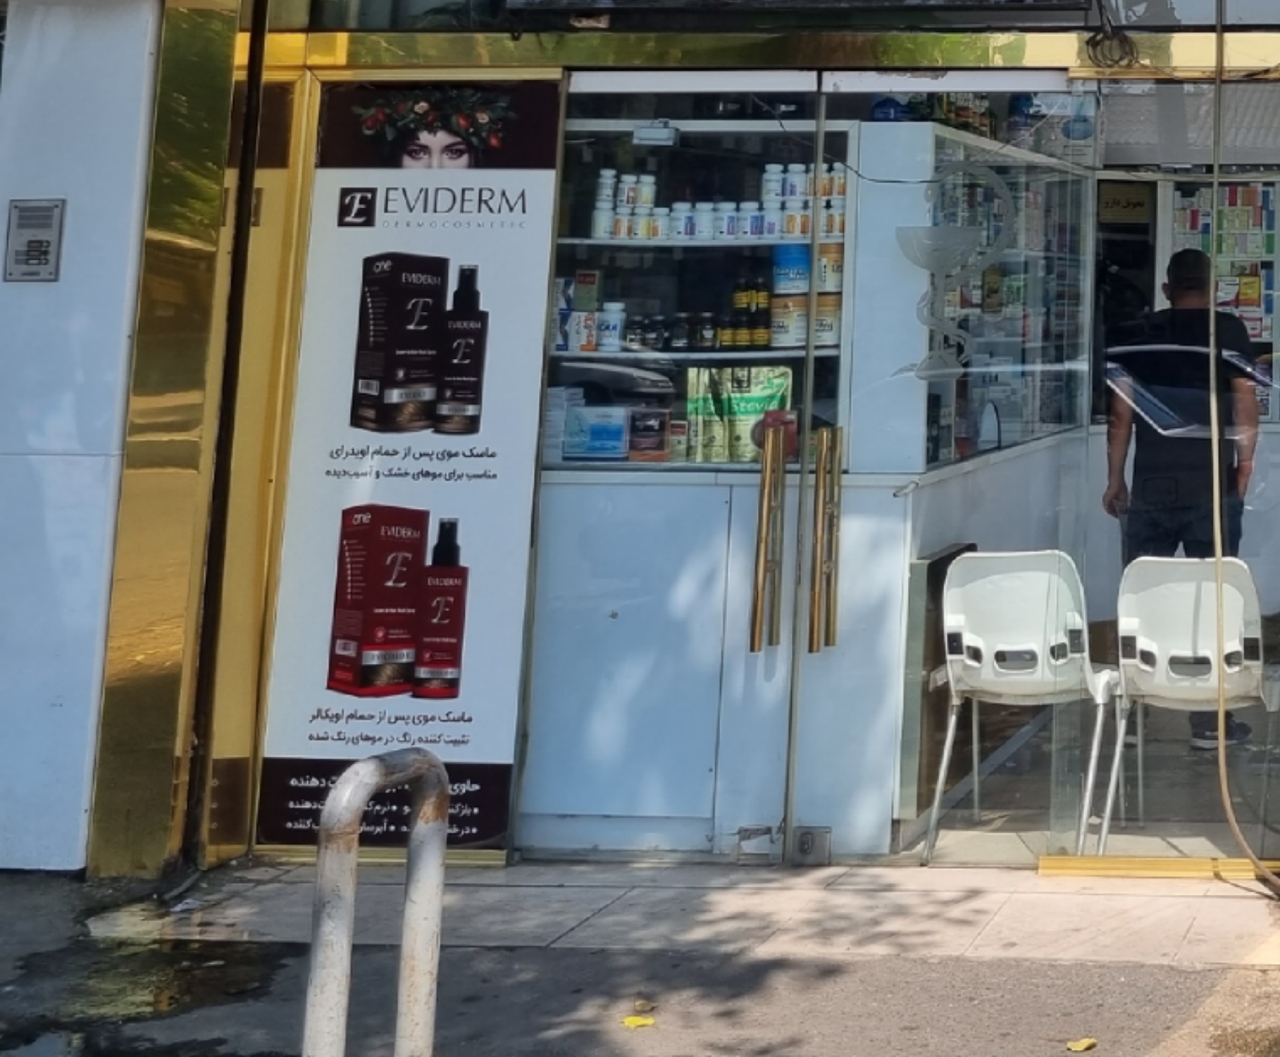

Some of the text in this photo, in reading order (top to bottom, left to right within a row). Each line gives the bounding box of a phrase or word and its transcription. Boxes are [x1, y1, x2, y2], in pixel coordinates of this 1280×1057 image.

[383, 187, 527, 214] EVIDERM
[731, 399, 778, 412] Stevia
[370, 446, 399, 460] حمام
[402, 446, 411, 460] از
[413, 448, 435, 462] پس
[436, 448, 460, 461] موی
[462, 446, 497, 459] ماسک
[383, 466, 410, 478] خشک
[412, 468, 443, 481] موهای
[444, 468, 464, 481] برای
[465, 467, 498, 480] مناسب
[345, 709, 375, 724] حمام
[377, 709, 386, 725] از
[387, 711, 411, 725] پس
[412, 712, 437, 726] موی
[438, 711, 473, 723] ماسک
